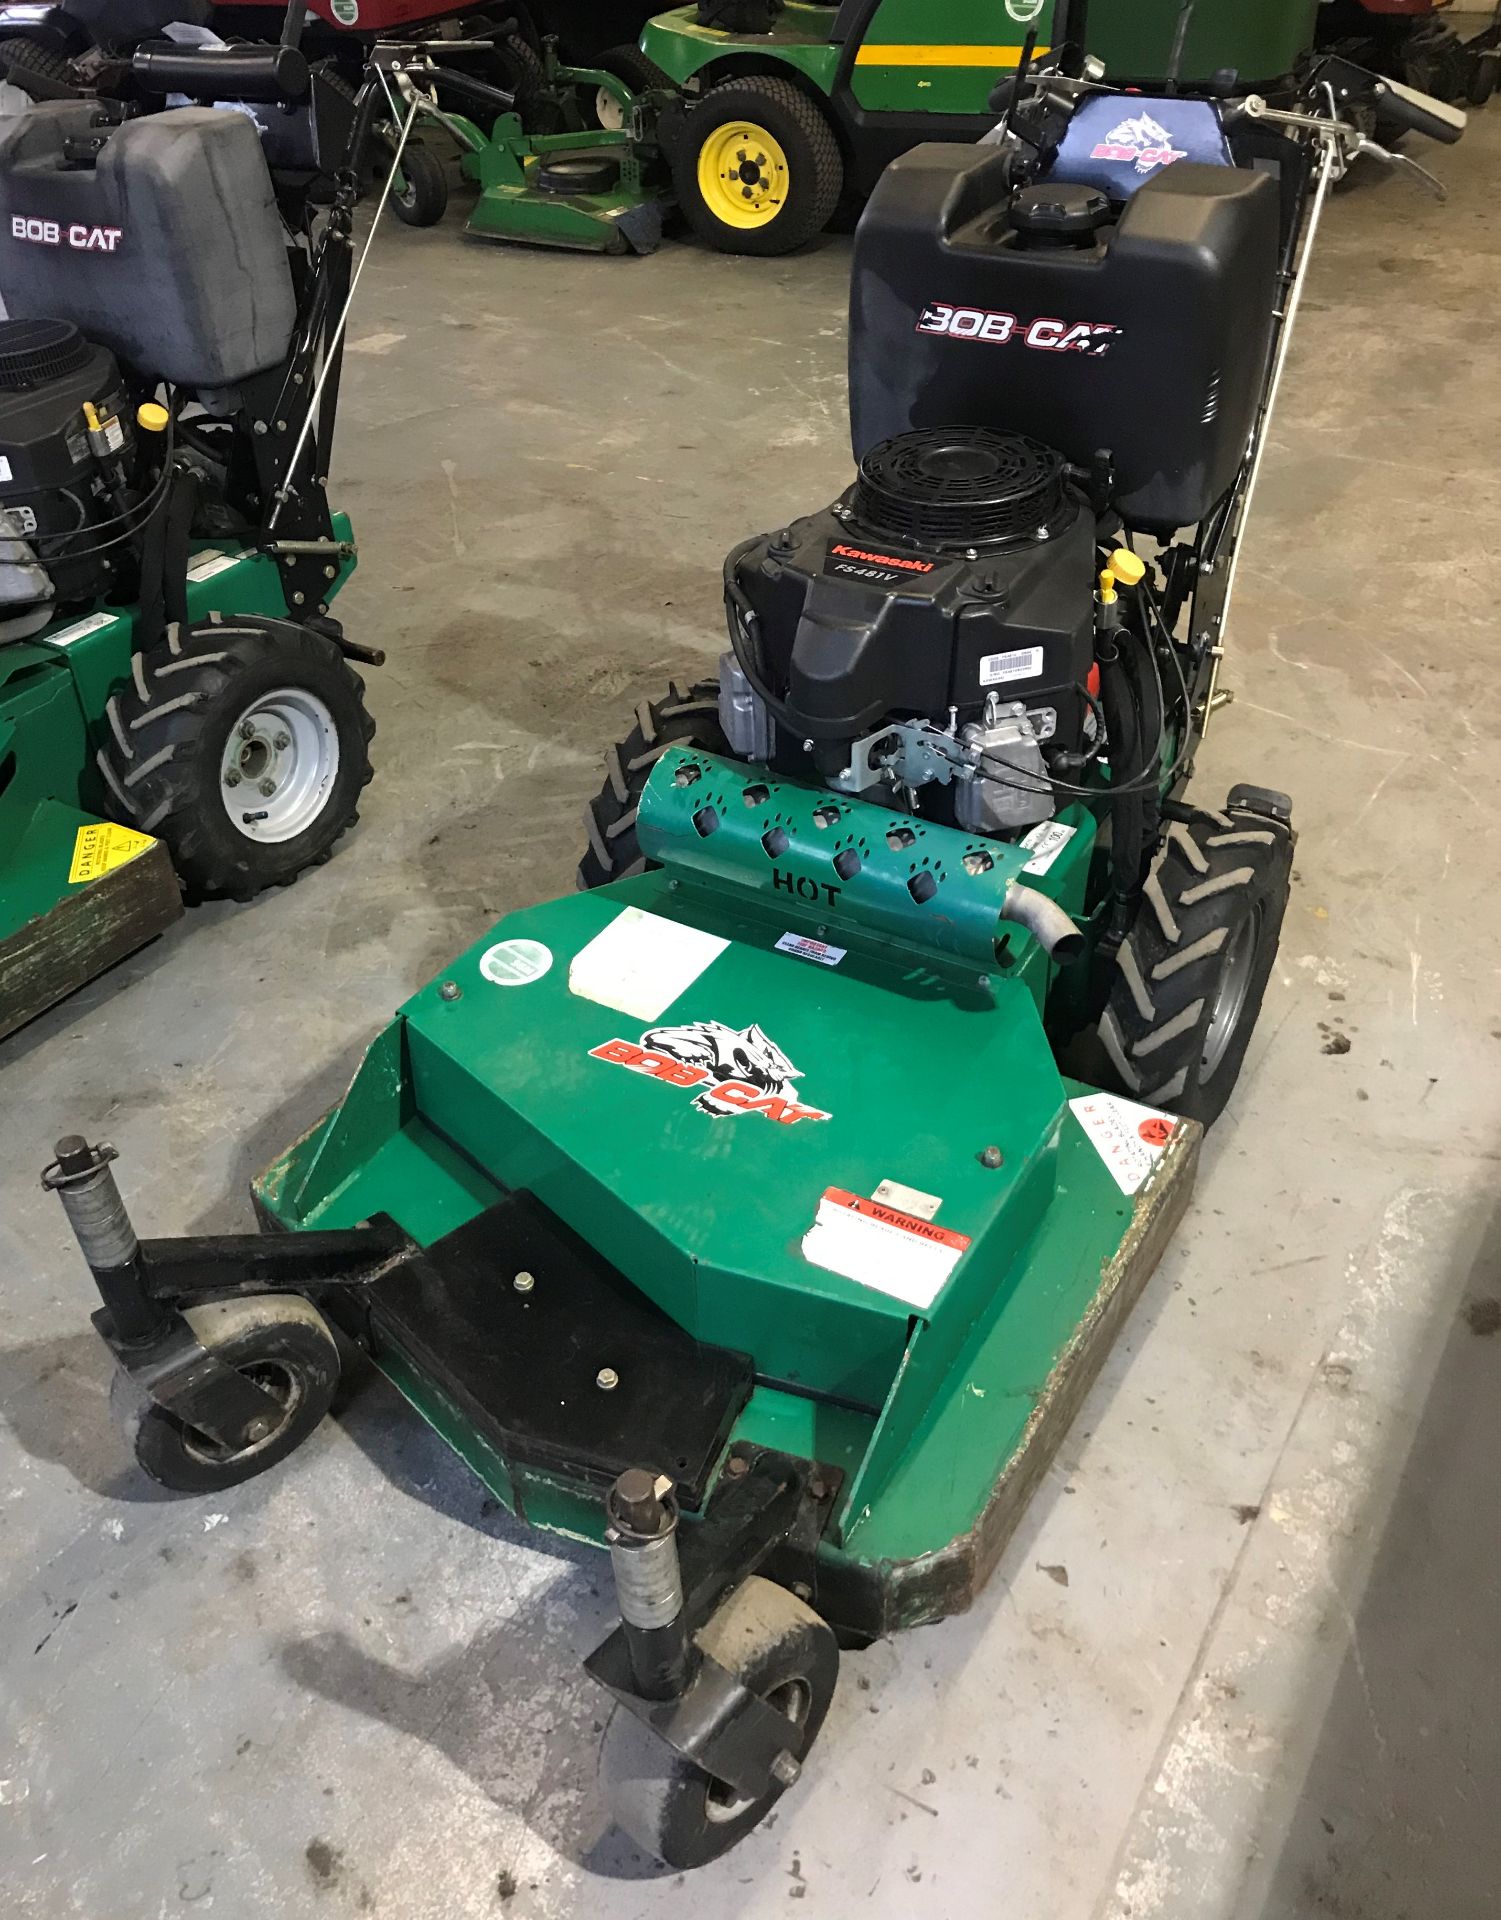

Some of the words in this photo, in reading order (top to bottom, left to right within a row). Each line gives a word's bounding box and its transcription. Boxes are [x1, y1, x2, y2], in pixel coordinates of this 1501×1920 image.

[831, 545, 934, 572] Kawasaki
[834, 563, 899, 581] FS481V
[78, 829, 97, 877] DANGER
[773, 868, 842, 907] HOT
[588, 1038, 832, 1124] BOB-CAT
[1083, 1104, 1141, 1182] DANGER
[871, 1206, 946, 1242] WARNING
